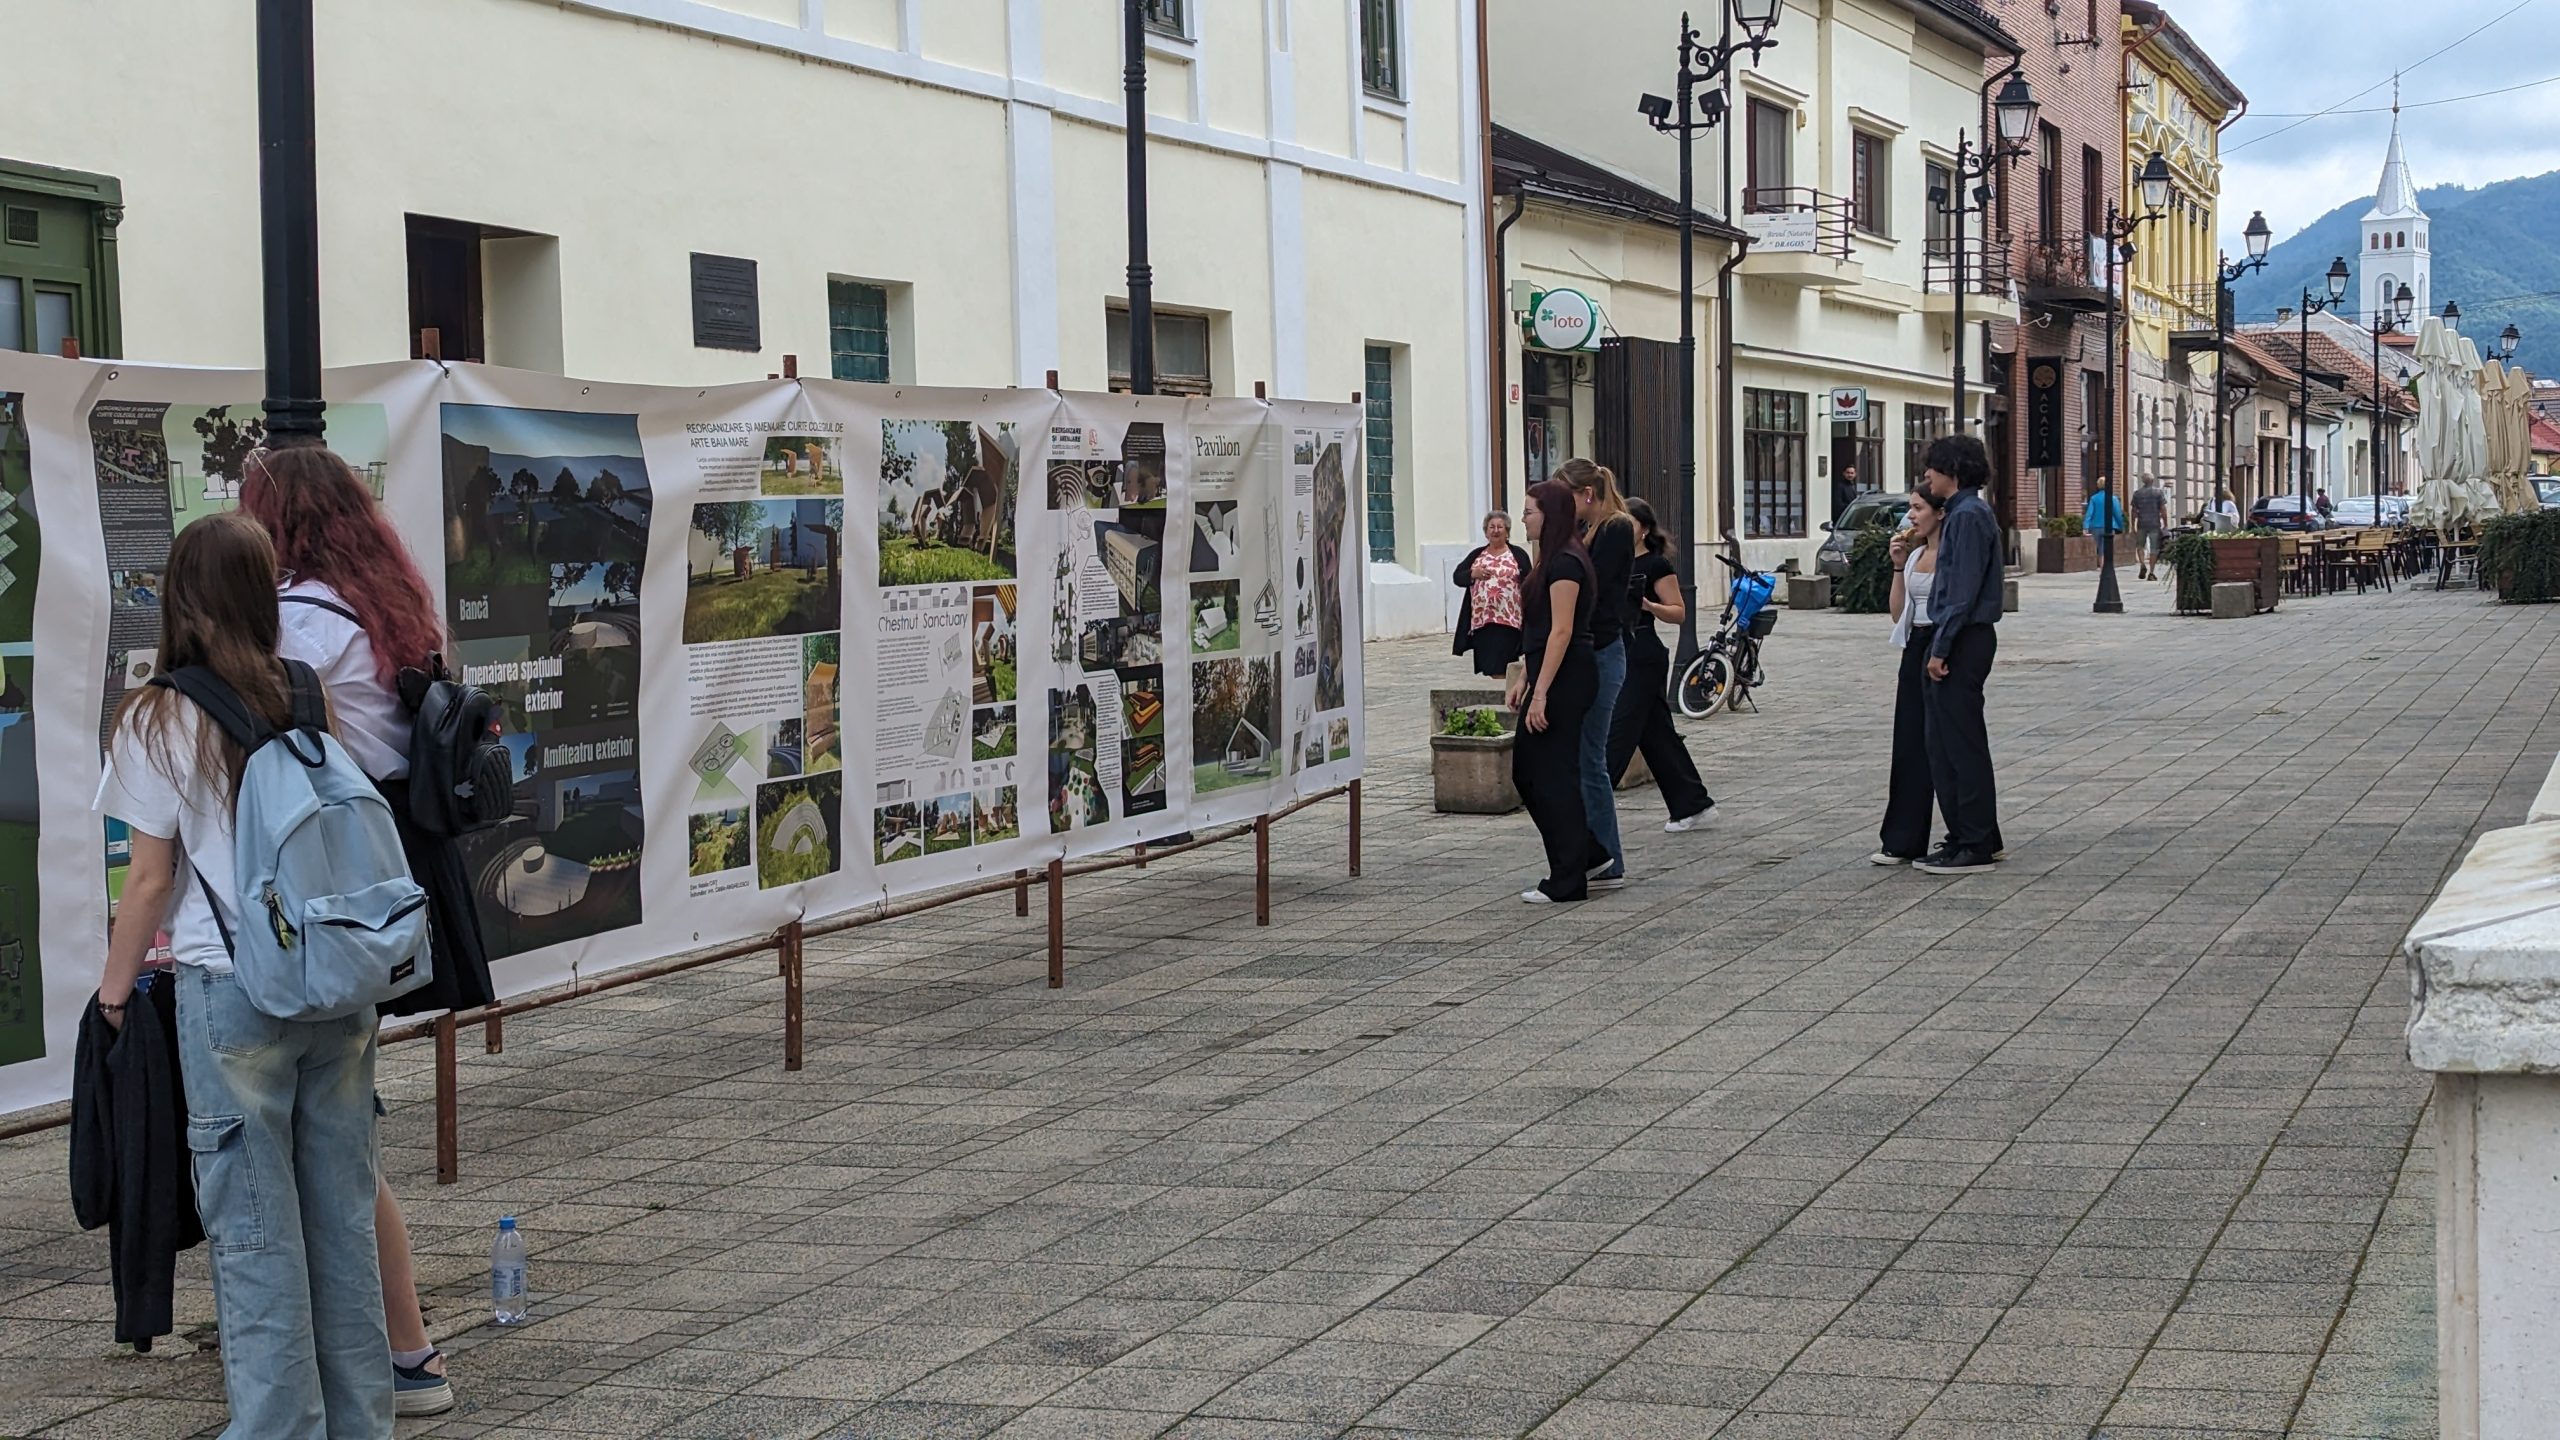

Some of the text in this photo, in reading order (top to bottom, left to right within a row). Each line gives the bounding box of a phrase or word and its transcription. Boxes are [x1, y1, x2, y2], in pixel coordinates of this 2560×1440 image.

[1553, 315, 1584, 328] loto
[686, 423, 745, 433] REORGANIZARE
[834, 422, 845, 432] DE
[2039, 393, 2049, 460] ACACIA
[690, 437, 749, 447] ARTE BAIA MARE
[1195, 435, 1241, 457] Pavilion
[459, 595, 489, 621] Bancă
[878, 612, 968, 632] Chestnut Sanctuary
[462, 654, 563, 686] Amenajarea spațiului
[524, 688, 564, 713] exterior
[543, 735, 634, 769] Amfiteatru exterior
